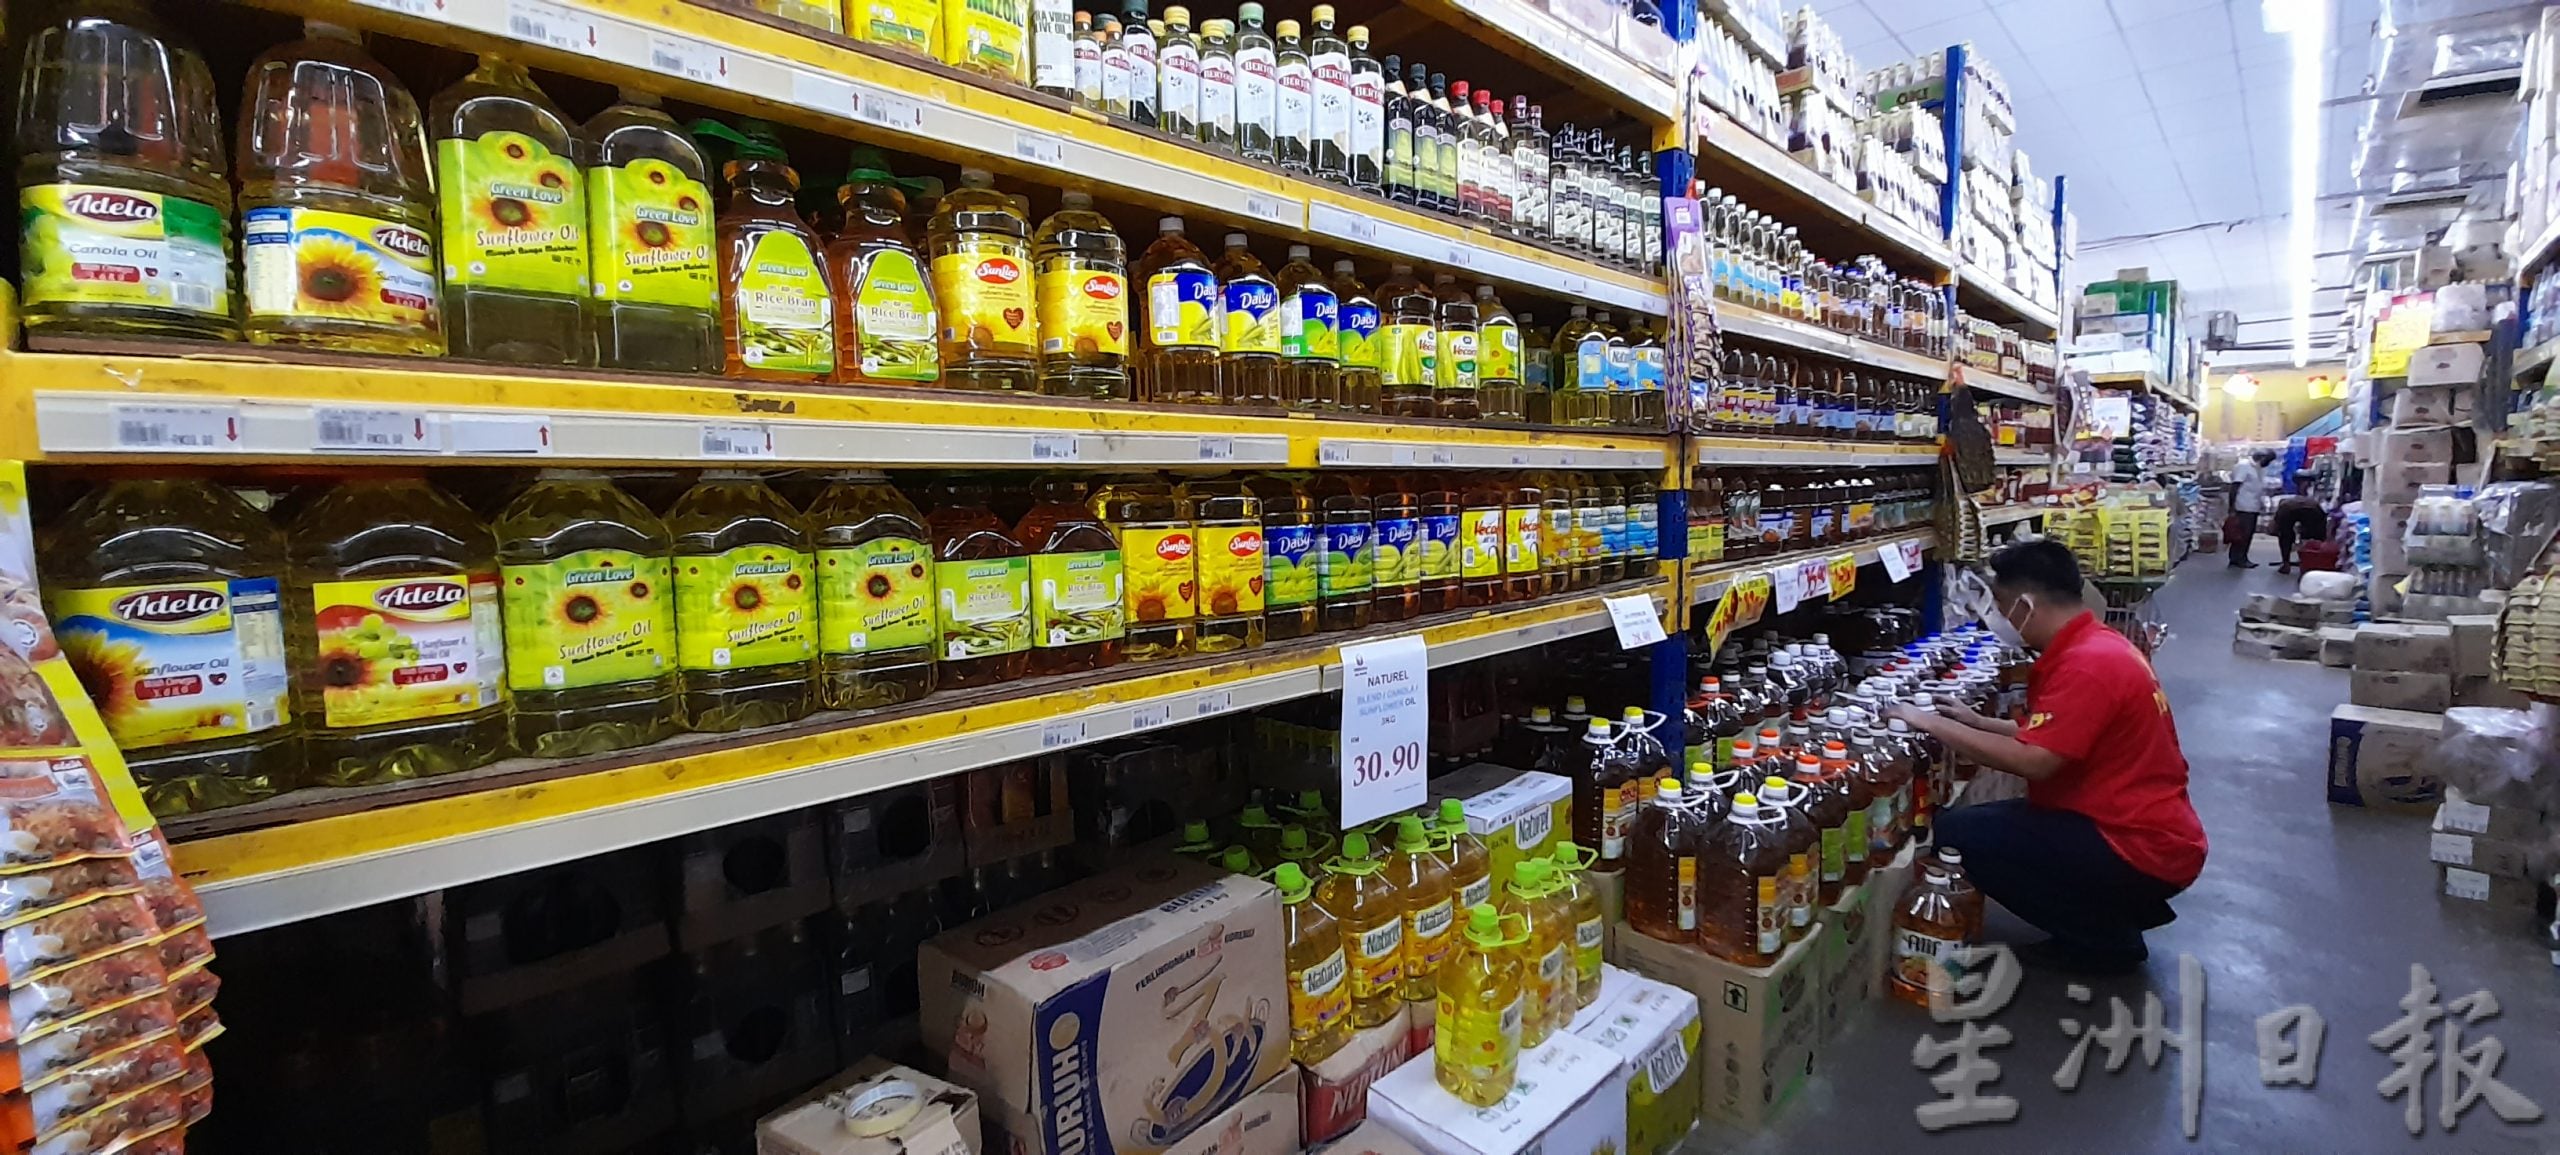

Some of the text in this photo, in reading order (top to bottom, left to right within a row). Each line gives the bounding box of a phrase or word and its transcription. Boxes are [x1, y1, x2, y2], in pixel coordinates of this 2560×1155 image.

[491, 183, 561, 203] Green Love
[68, 194, 153, 219] Adela
[636, 206, 697, 225] Green Love
[477, 225, 579, 247] Sunflower Oil
[69, 243, 158, 260] Canola Oil
[625, 249, 691, 266] Sunflower
[755, 292, 816, 307] Rice Bran
[1240, 292, 1272, 309] Daisy
[871, 307, 923, 321] Rice Bran
[1350, 313, 1377, 329] Daisy
[1280, 532, 1311, 554] Daisy
[736, 563, 789, 574] Green Love
[868, 553, 913, 565] Green Love
[567, 568, 633, 583] Green Love
[119, 592, 222, 620] Adela
[380, 585, 462, 609] Adela
[863, 595, 925, 627] Sunflower Oil
[727, 607, 802, 642] Sunflower Oil
[560, 619, 652, 659] Sunflower Oil
[135, 658, 229, 676] Sunflower Oil
[1367, 670, 1409, 688] NATUREL
[1404, 697, 1416, 706] OIL
[1353, 741, 1420, 788] 30.90
[1518, 808, 1549, 845] Naturel
[1904, 934, 1942, 957] Alif
[1053, 1044, 1086, 1155] URUH
